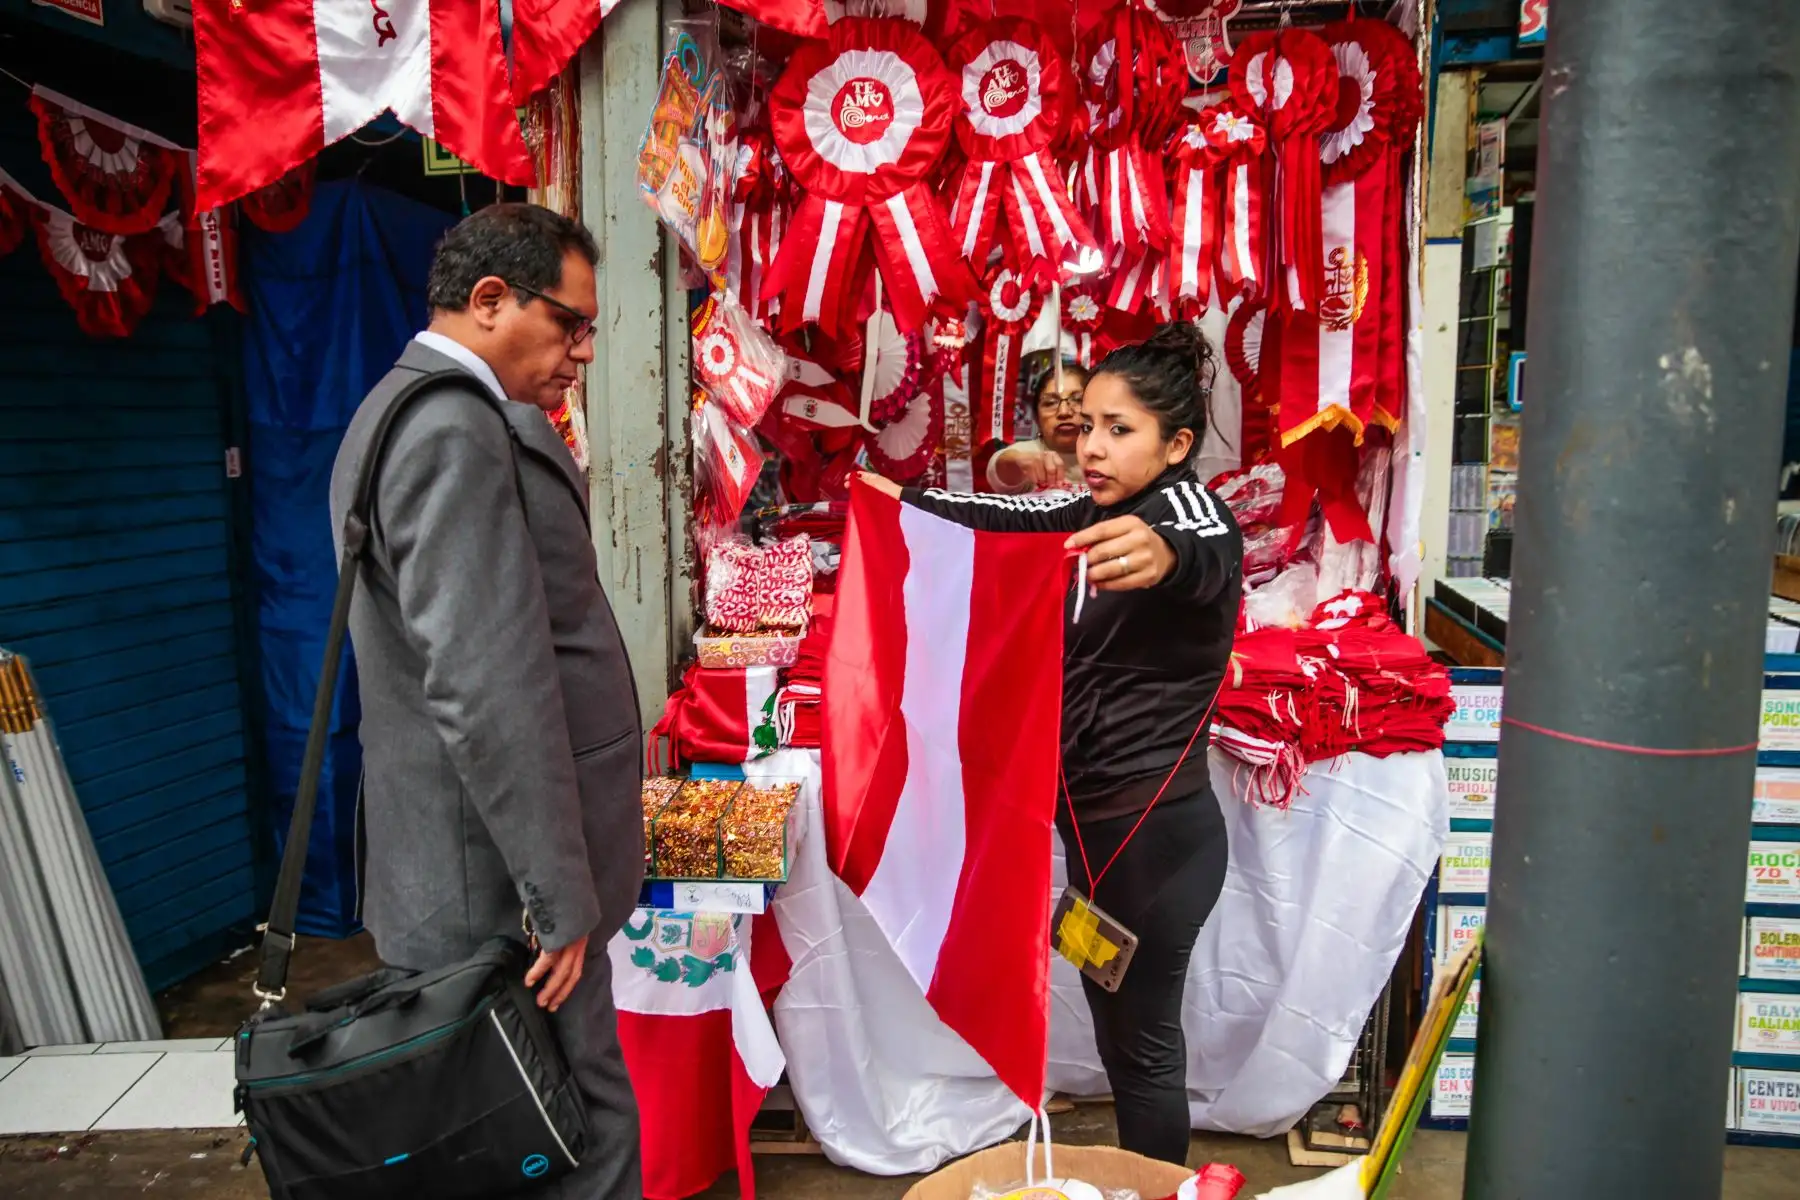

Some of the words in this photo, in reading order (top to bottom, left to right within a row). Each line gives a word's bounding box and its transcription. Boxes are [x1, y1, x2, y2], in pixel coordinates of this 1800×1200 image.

[991, 63, 1012, 80] TE
[852, 81, 876, 94] TE
[997, 343, 1006, 372] VIVA
[996, 377, 1003, 392] EL
[1475, 708, 1502, 721] OR
[1448, 767, 1497, 782] MUSIC
[1751, 852, 1800, 867] ROC
[1760, 932, 1800, 945] BOLER
[1440, 1080, 1458, 1092] EN
[1750, 1098, 1765, 1109] EN
